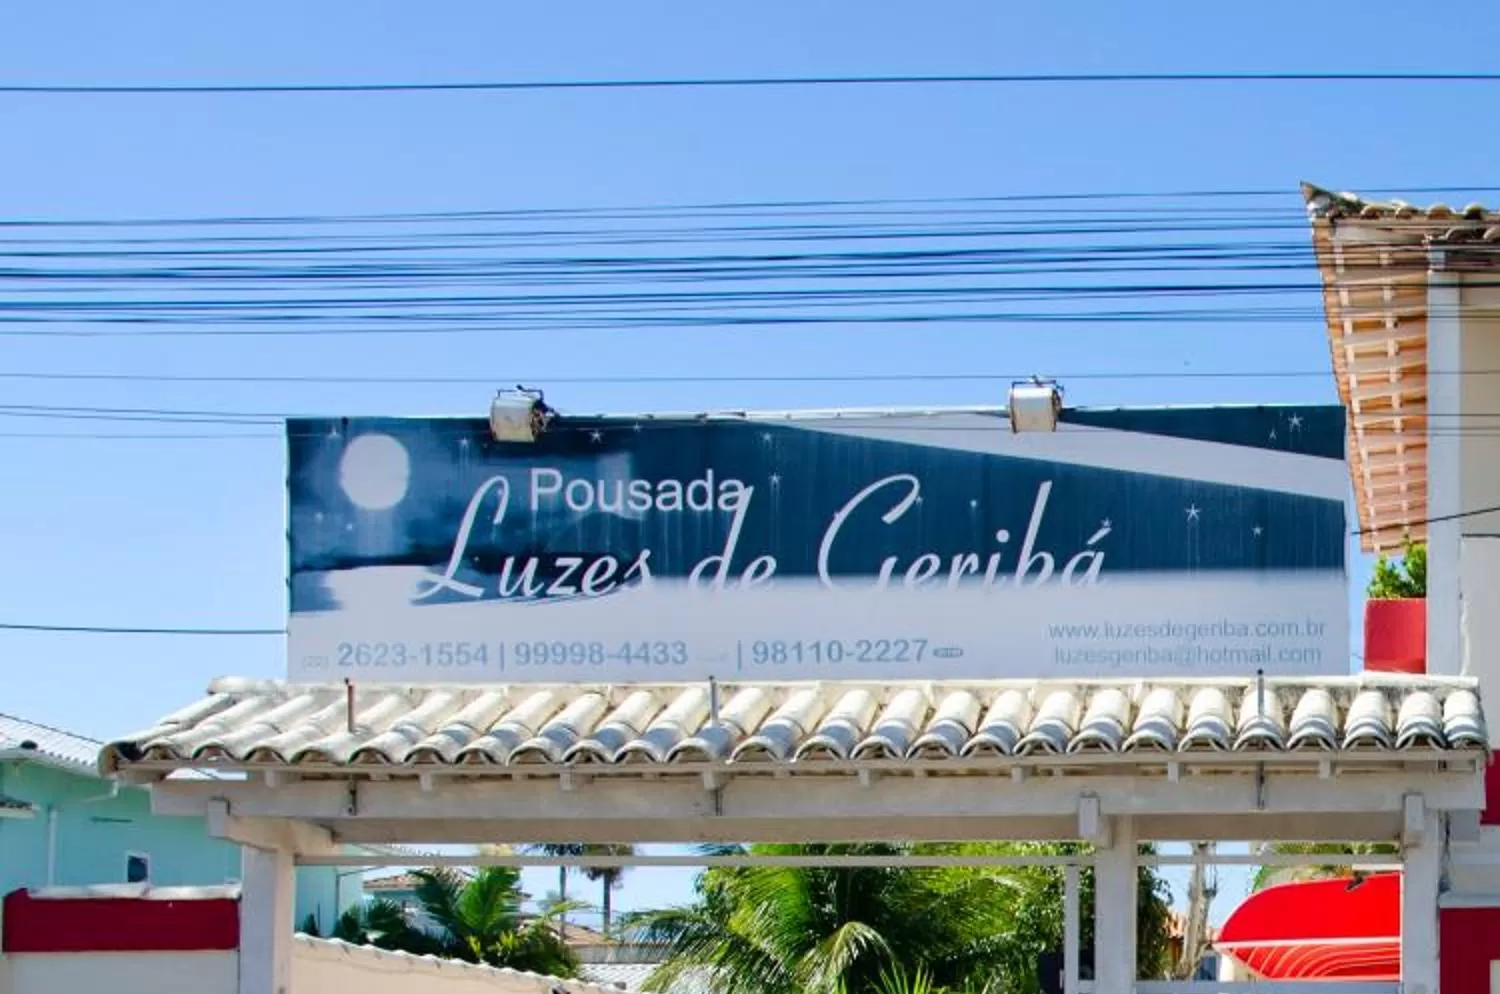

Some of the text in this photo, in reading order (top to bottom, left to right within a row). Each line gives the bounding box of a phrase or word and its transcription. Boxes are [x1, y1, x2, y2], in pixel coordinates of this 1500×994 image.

[530, 467, 745, 513] Pousada
[413, 473, 1113, 600] Luzes de Geribá
[1048, 617, 1327, 642] www.luzesdegeriba.com.br
[336, 640, 489, 667] 2623-1554
[514, 639, 689, 666] 99998-4433
[752, 638, 929, 665] 98110-2227
